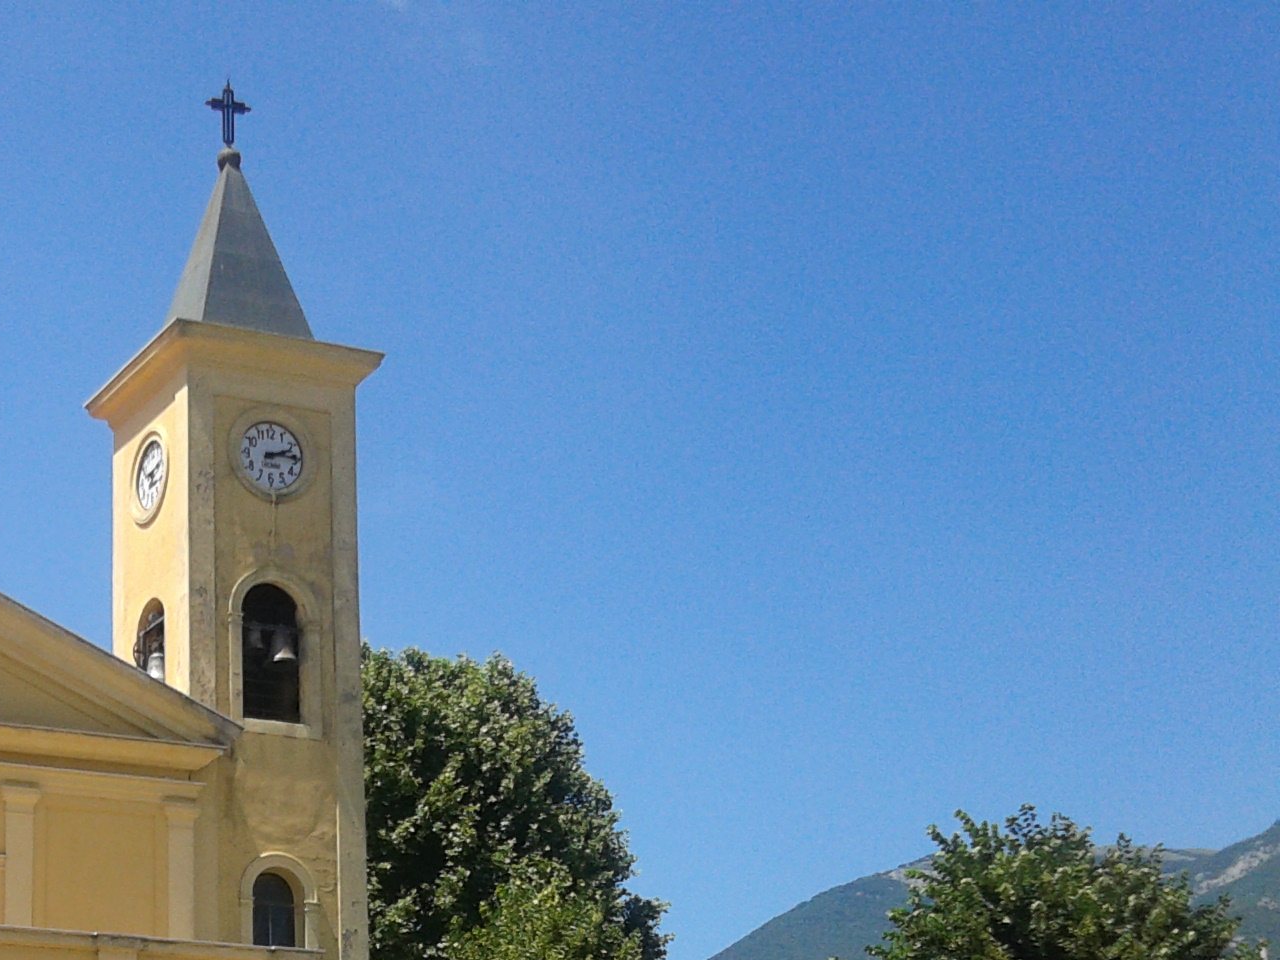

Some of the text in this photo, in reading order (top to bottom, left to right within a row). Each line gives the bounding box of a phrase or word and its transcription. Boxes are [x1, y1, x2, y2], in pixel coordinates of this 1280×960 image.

[256, 429, 264, 440] 11
[266, 428, 275, 440] 12
[247, 437, 258, 448] 10
[287, 442, 293, 453] 2
[244, 447, 250, 458] 9
[249, 460, 254, 471] 8
[288, 466, 293, 476] 4
[258, 469, 263, 480] 7
[268, 473, 274, 484] 6
[279, 472, 286, 483] 5
